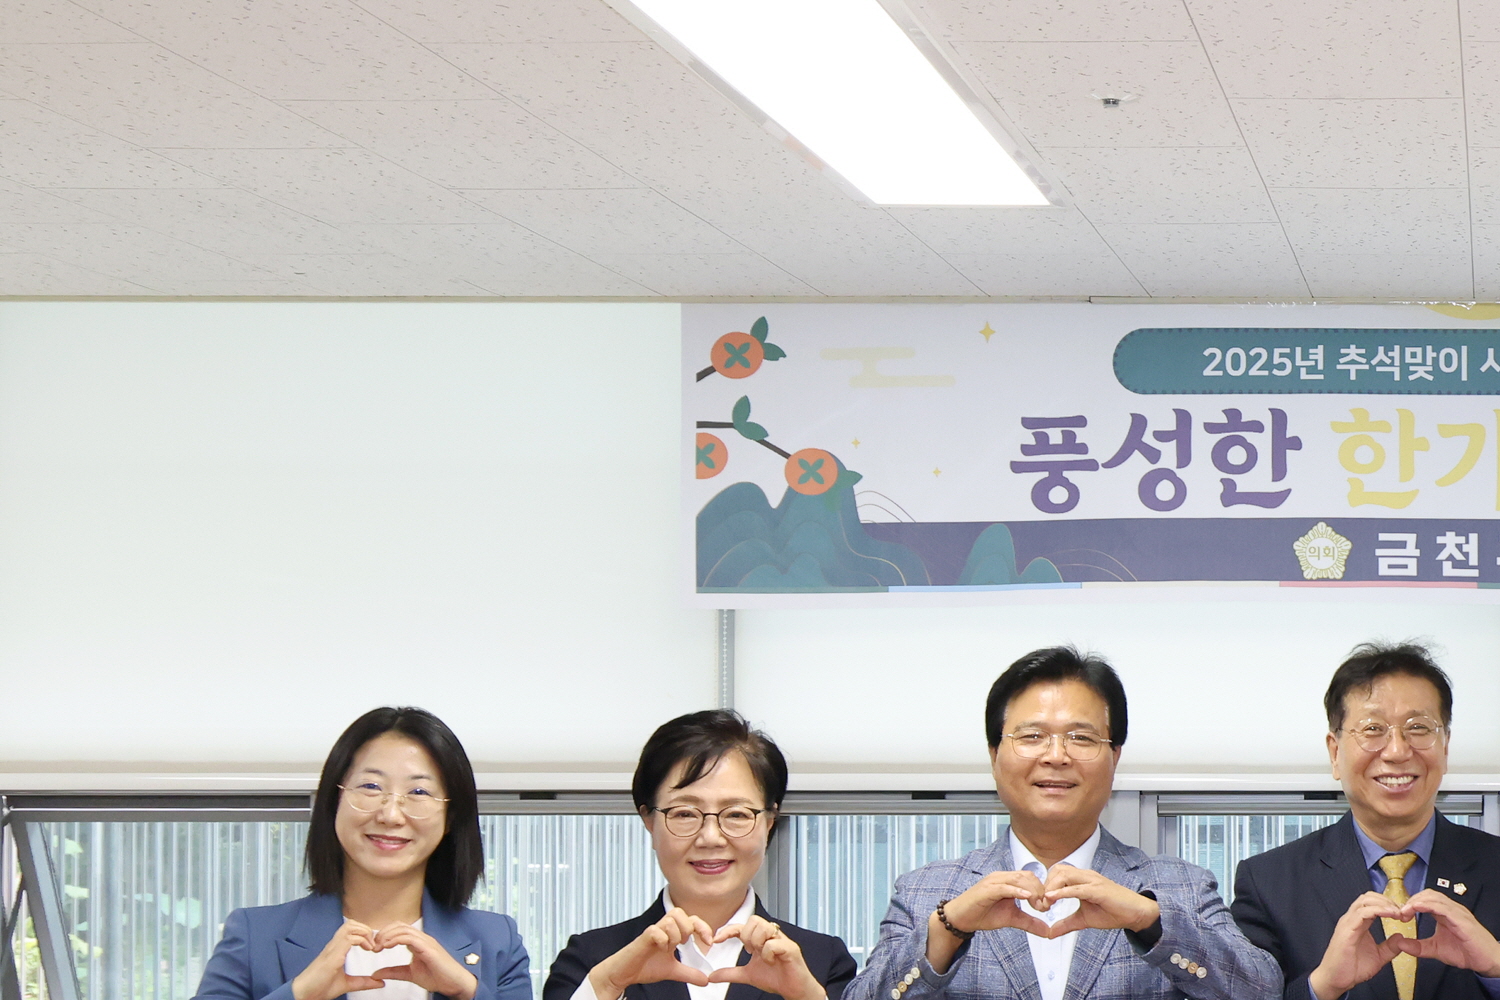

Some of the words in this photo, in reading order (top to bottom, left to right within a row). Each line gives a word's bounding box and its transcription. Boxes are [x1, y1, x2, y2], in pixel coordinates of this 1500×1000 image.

[1202, 344, 1325, 381] 2025년
[1336, 344, 1468, 382] 추석맞이
[1009, 407, 1303, 514] 풍성한
